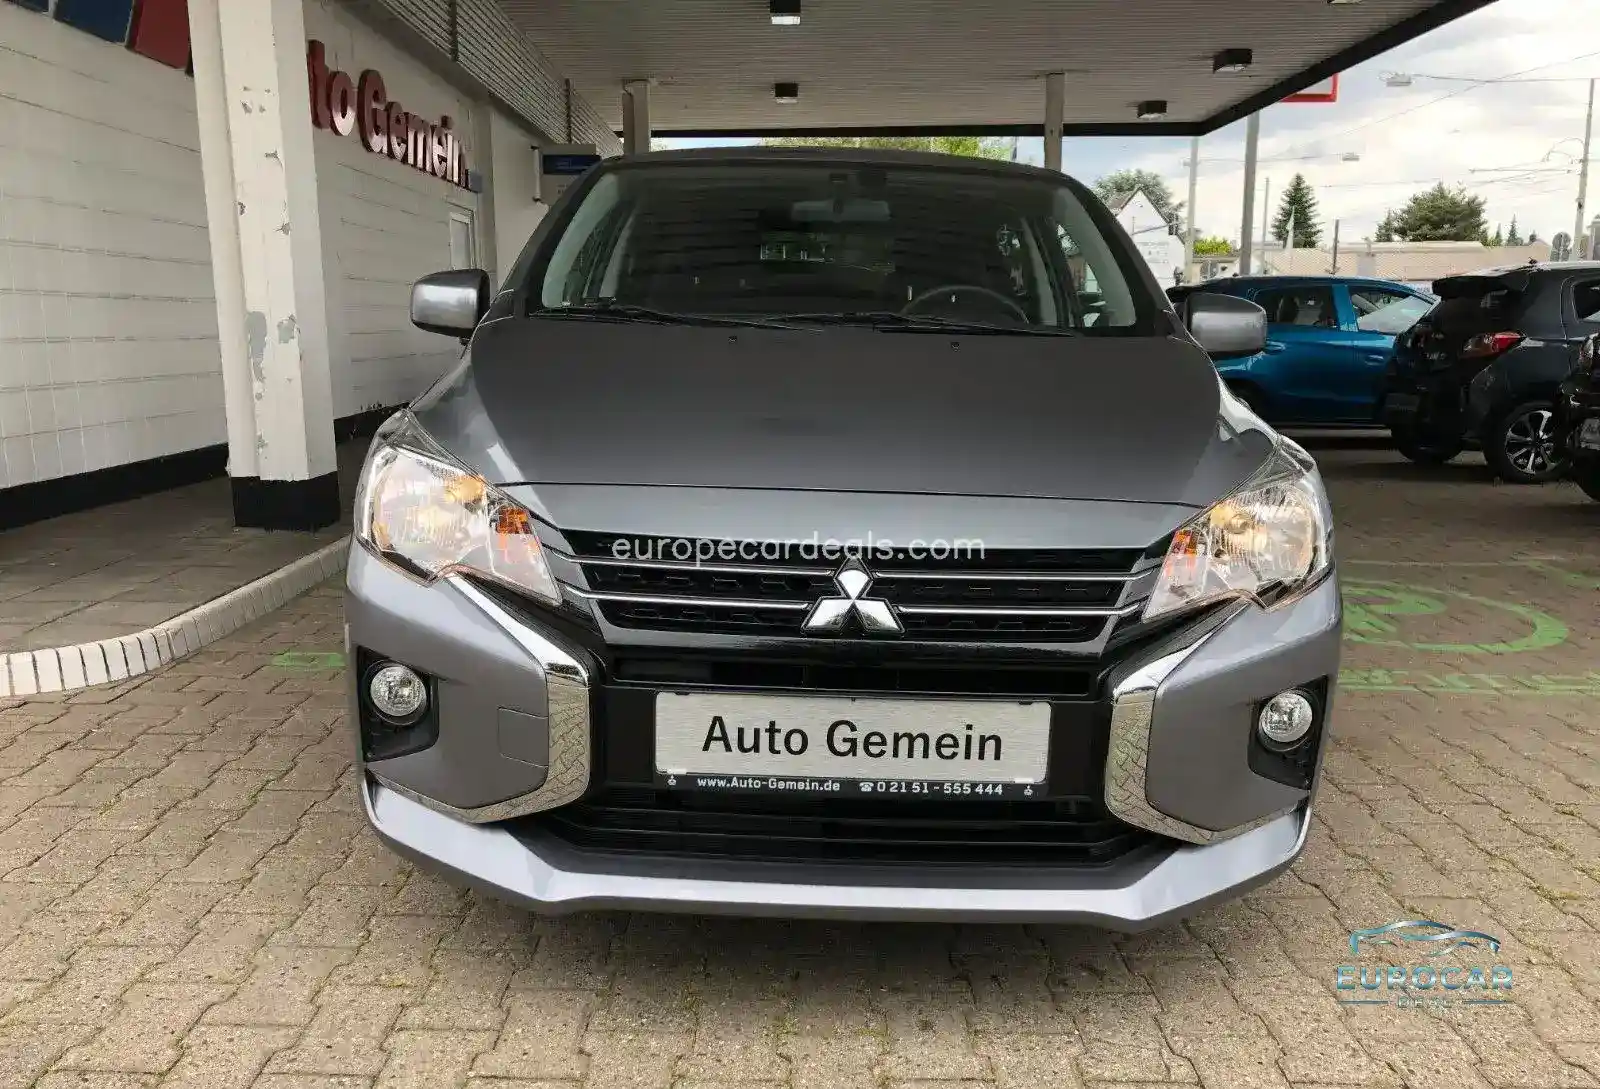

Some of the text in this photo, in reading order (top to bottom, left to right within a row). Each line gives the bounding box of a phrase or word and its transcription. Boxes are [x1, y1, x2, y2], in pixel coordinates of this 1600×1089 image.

[307, 39, 470, 190] to Gemein
[702, 715, 1002, 761] Auto Gemein
[697, 776, 840, 791] www.Auto-Gemein.de
